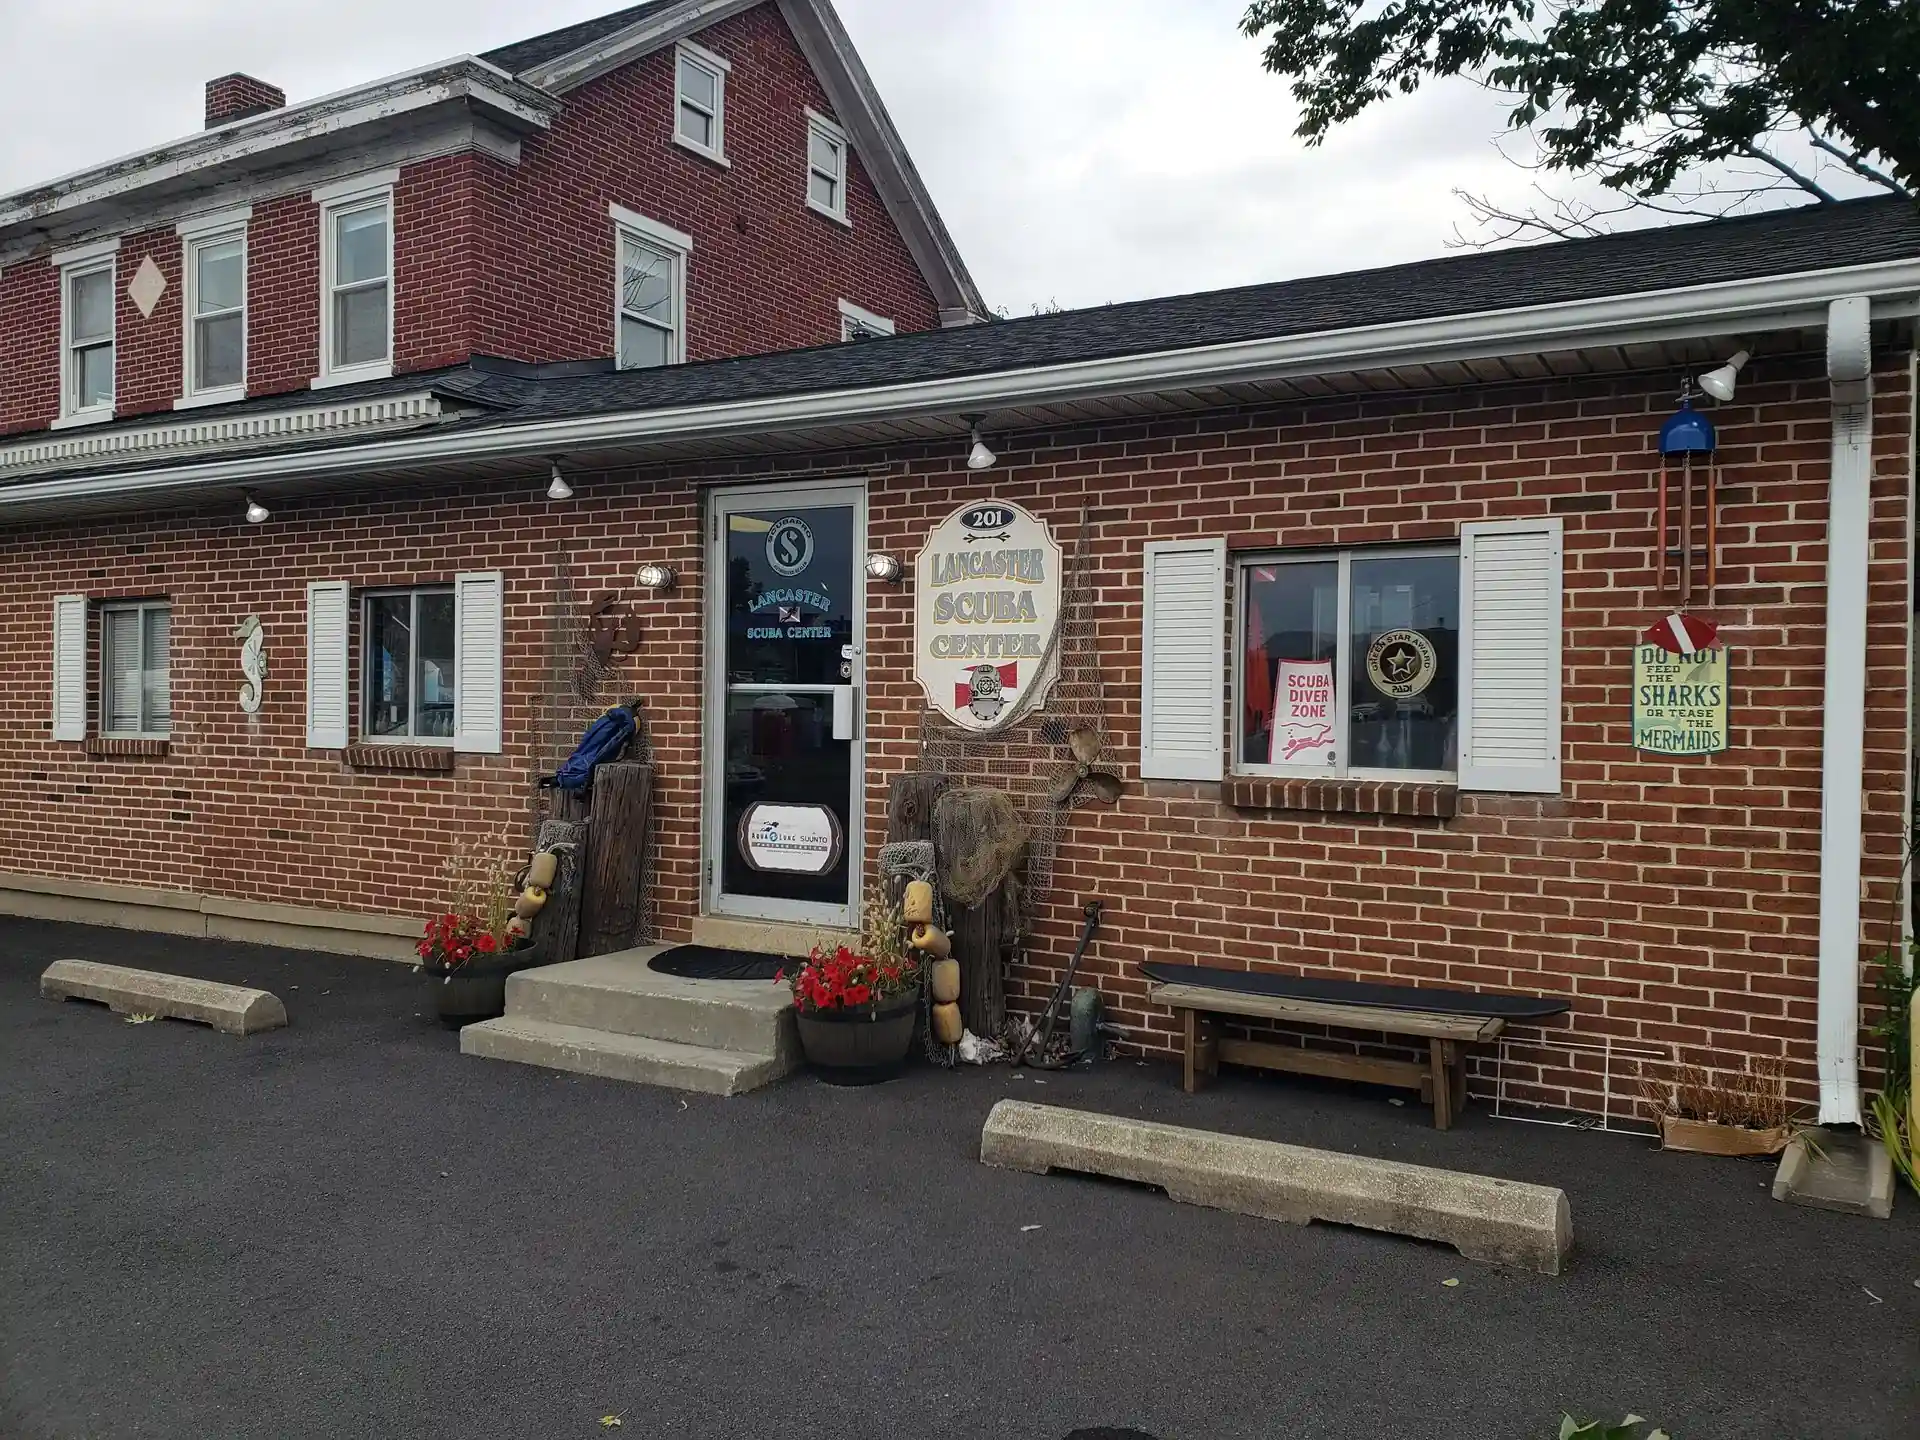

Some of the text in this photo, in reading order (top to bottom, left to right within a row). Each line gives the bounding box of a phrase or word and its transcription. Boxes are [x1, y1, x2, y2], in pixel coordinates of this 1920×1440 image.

[972, 509, 1003, 527] 201
[768, 518, 812, 543] SCUBAPRO
[780, 530, 798, 563] S
[930, 548, 1045, 587] LANCASTER
[747, 588, 831, 613] LANCASTER
[933, 590, 1038, 625] SCUBA
[747, 626, 832, 639] SCUBA CENTER
[930, 633, 1043, 660] CENTER
[1372, 634, 1431, 671] GREEN STAR AWARD
[1641, 648, 1668, 664] DO
[1646, 665, 1681, 673] FEED
[1288, 674, 1329, 688] SCUBA
[1646, 674, 1673, 683] THE
[1289, 689, 1328, 703] DIVER
[1392, 684, 1413, 693] PADI
[1640, 685, 1721, 707] SHARKS
[1291, 704, 1326, 718] ZONE
[1646, 708, 1714, 718] OR TEASE
[1686, 719, 1713, 728] THE
[1640, 729, 1721, 751] MERMAIDS
[752, 832, 768, 840] AQUA
[800, 835, 828, 843] SUUNTO
